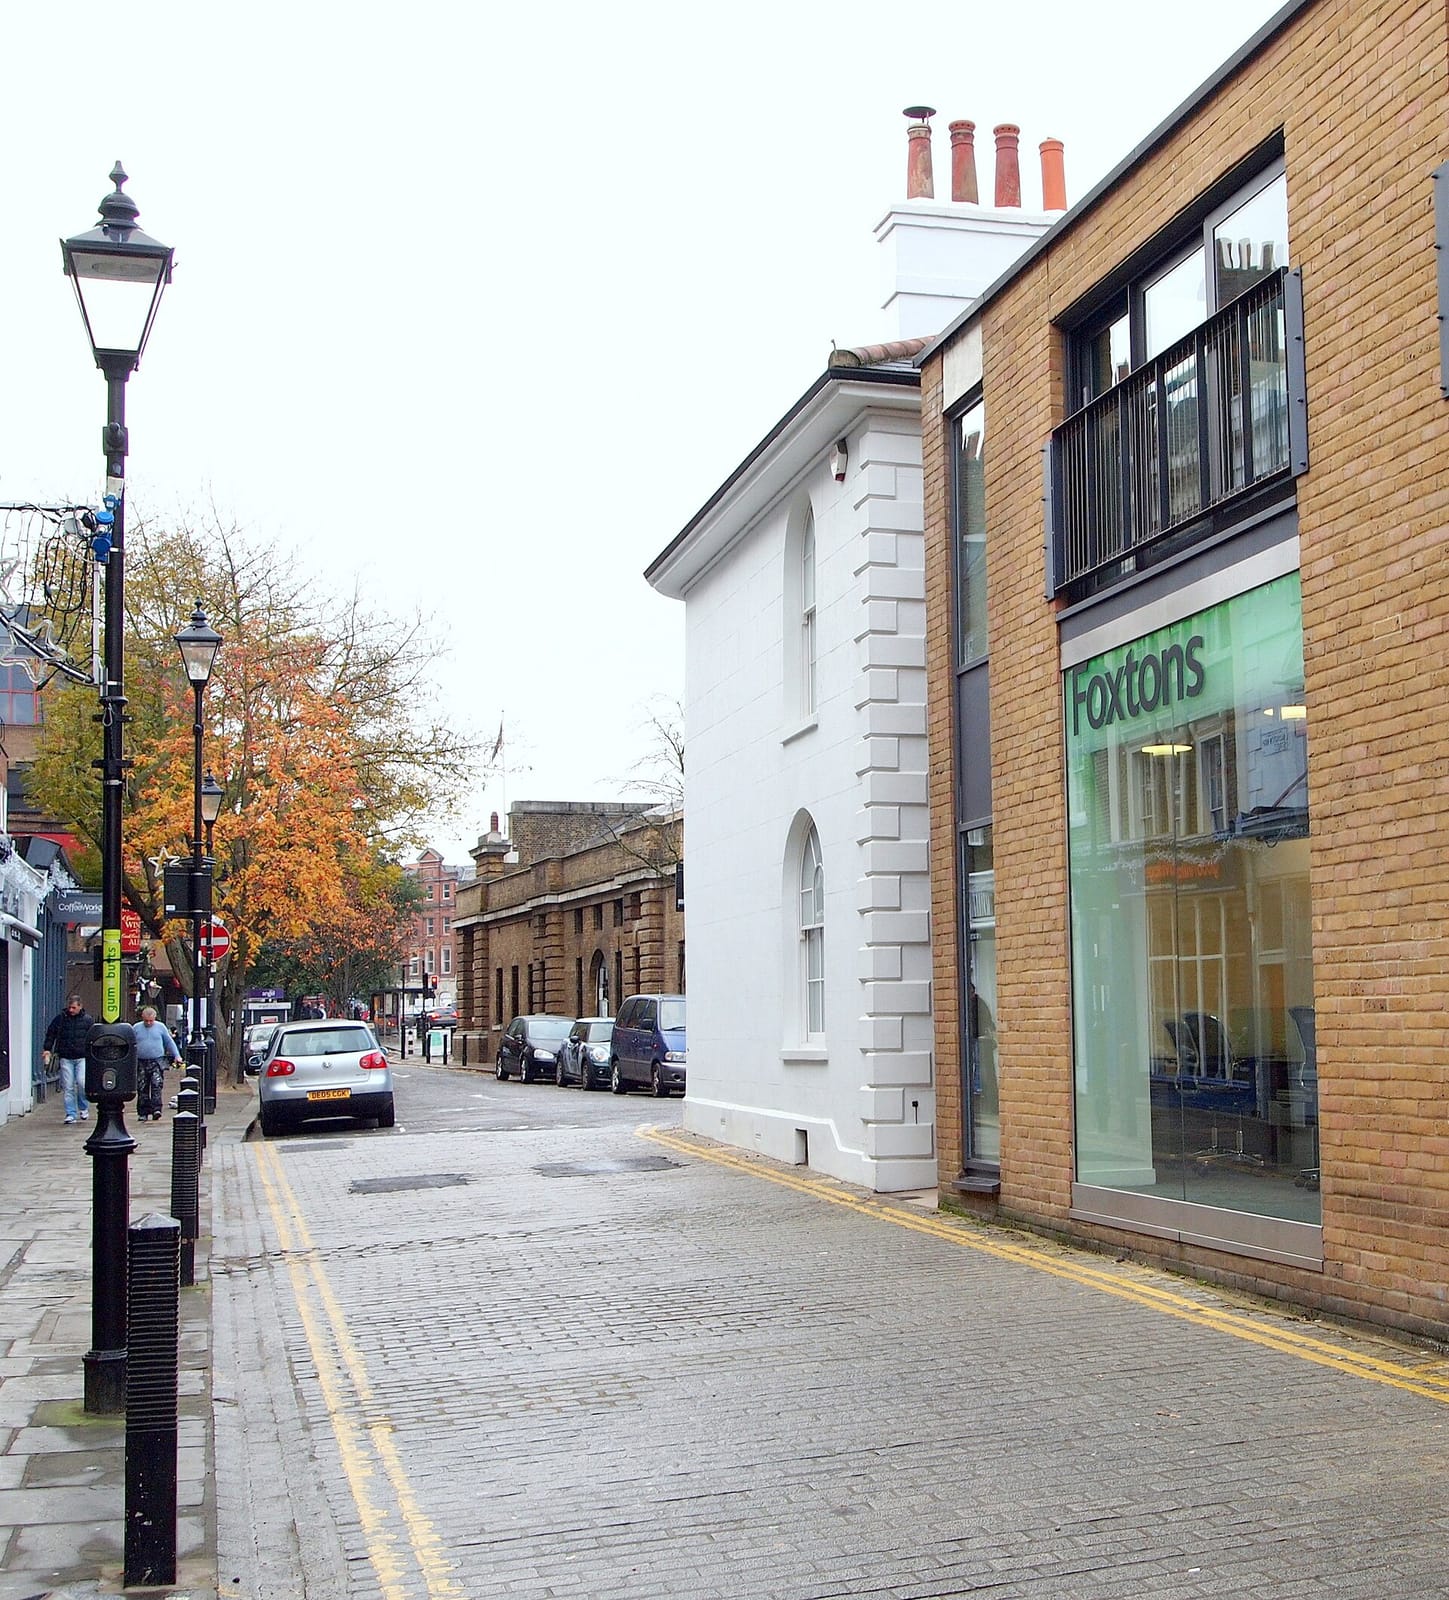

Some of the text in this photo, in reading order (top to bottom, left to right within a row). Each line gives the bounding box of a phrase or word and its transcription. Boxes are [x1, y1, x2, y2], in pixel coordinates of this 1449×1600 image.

[1072, 635, 1205, 737] Foxtons
[106, 947, 118, 1012] gum butts
